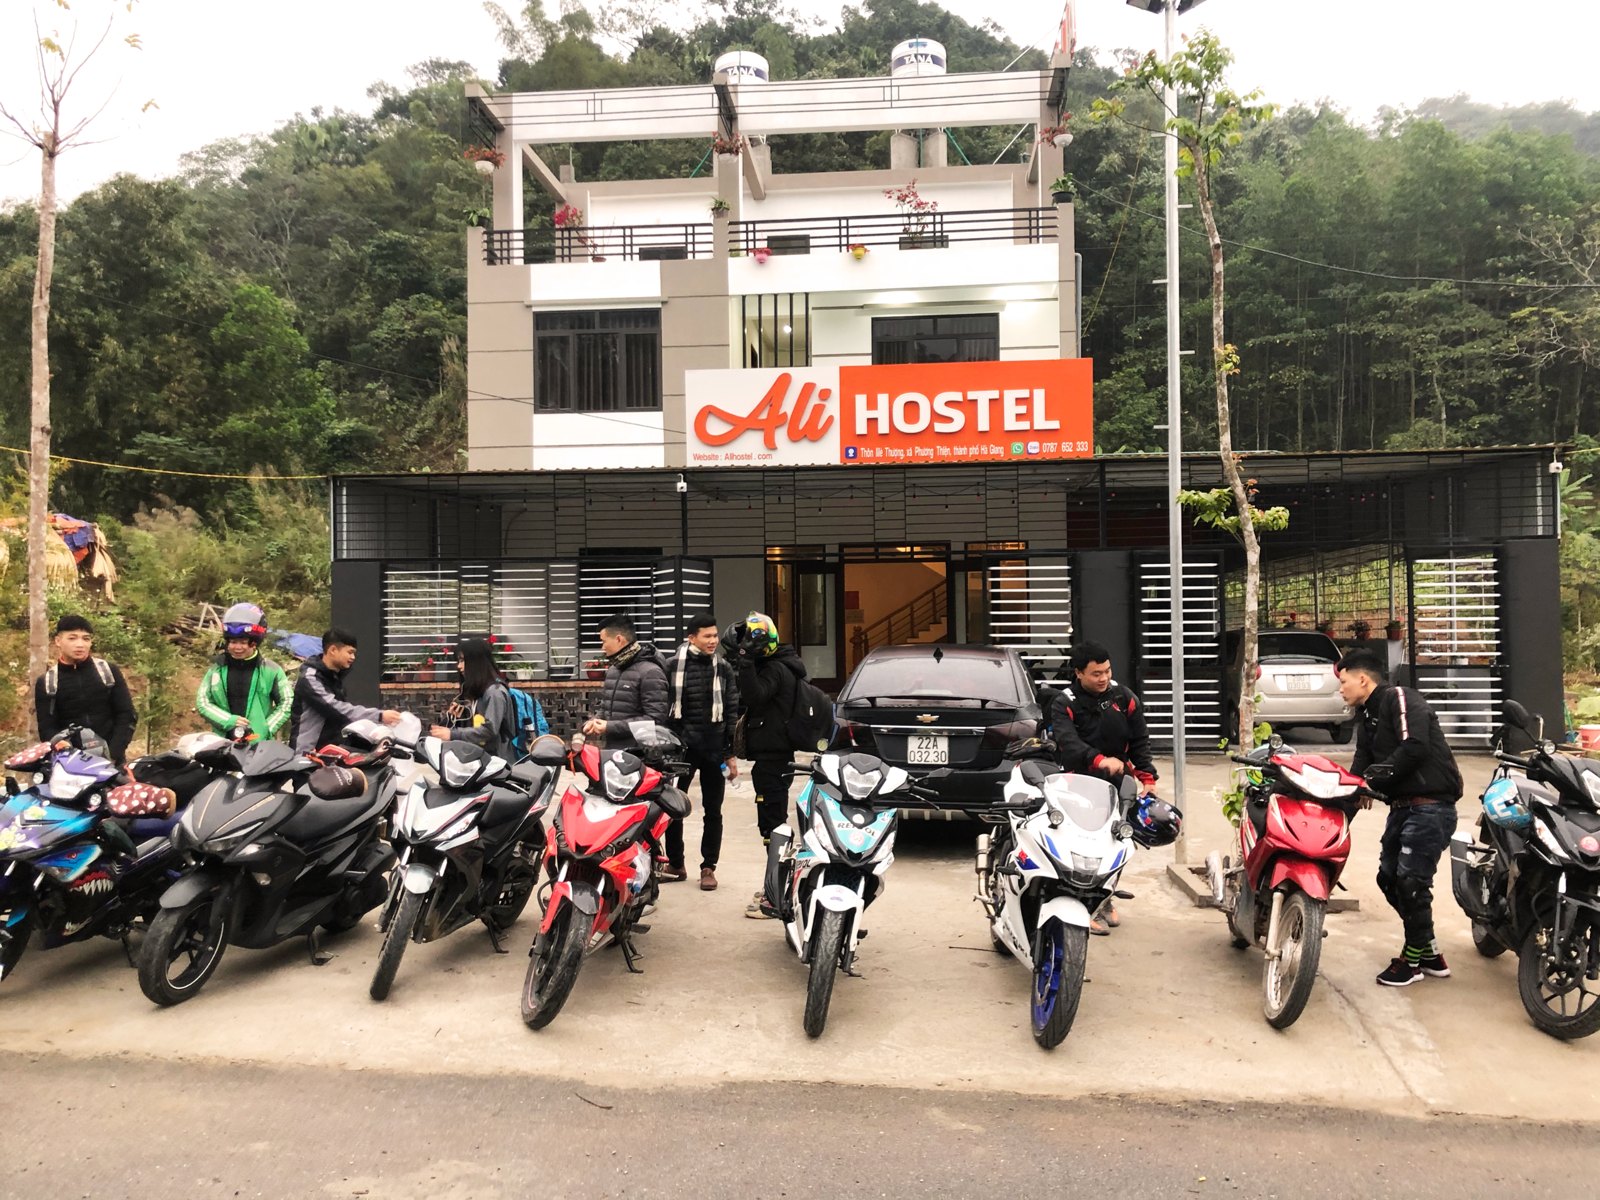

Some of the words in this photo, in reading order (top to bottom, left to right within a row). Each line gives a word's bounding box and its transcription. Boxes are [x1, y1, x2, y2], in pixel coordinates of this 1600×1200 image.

[694, 372, 834, 450] Ali
[854, 388, 1060, 435] HOSTEL
[1042, 442, 1058, 453] 0787
[1061, 441, 1073, 452] 652
[1076, 441, 1089, 451] 333
[917, 736, 938, 750] 22A
[909, 750, 947, 763] 032.30
